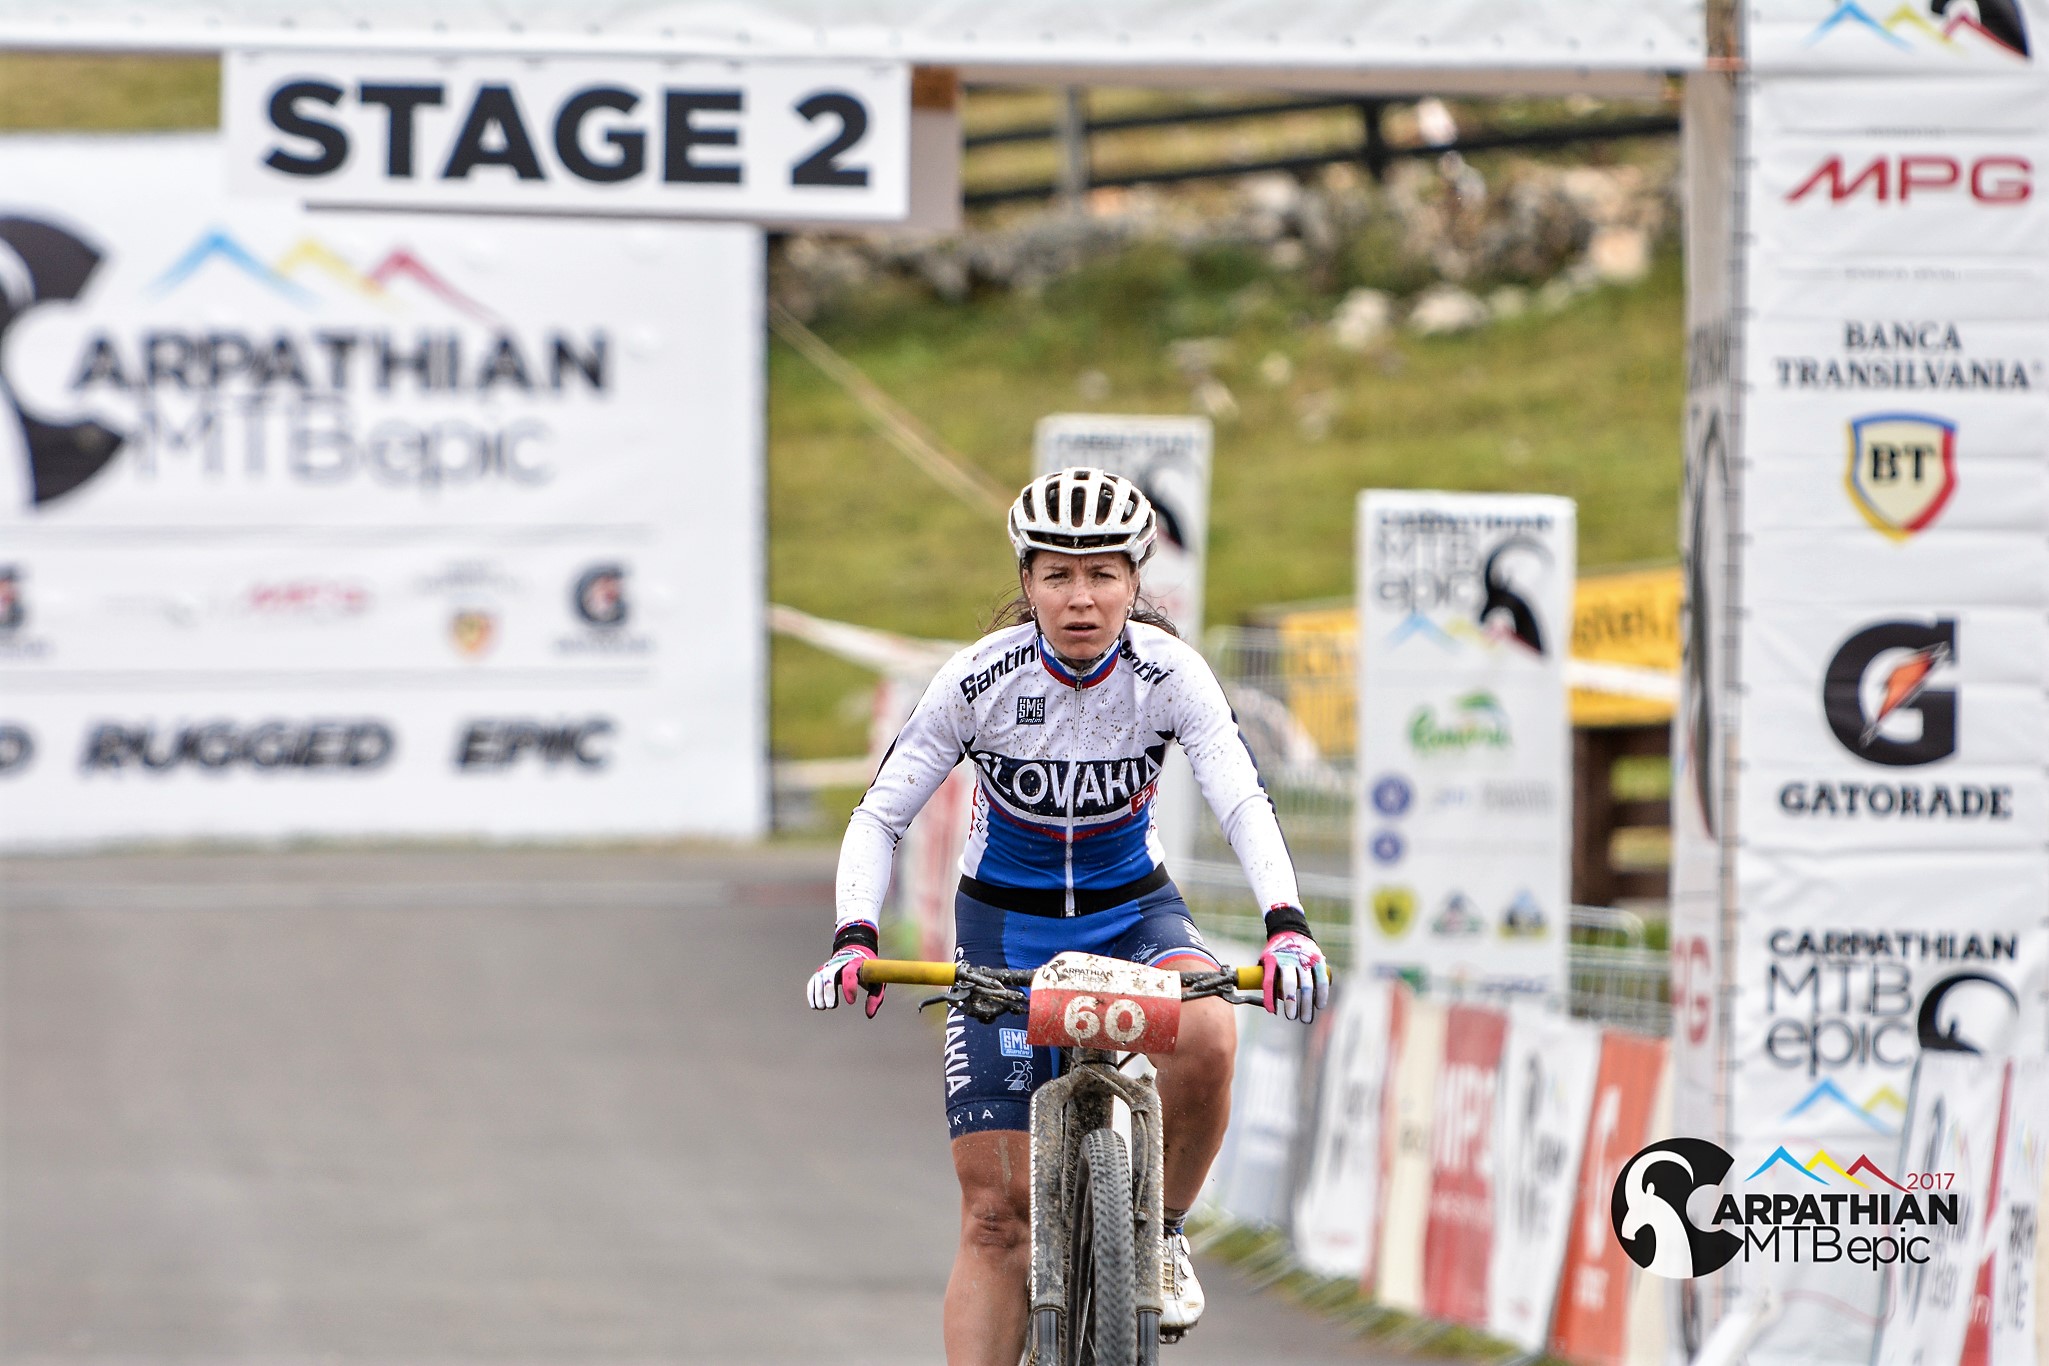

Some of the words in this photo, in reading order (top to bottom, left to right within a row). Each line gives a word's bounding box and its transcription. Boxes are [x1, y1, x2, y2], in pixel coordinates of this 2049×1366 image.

[263, 80, 744, 184] STAGE
[791, 91, 869, 186] 2
[1784, 153, 2034, 207] MPG
[1844, 321, 1963, 352] BANCA
[1870, 442, 1936, 484] BT
[959, 637, 1040, 705] Santini
[1823, 615, 1960, 768] G
[1778, 782, 2014, 819] GATORADE
[1768, 928, 2019, 960] CARPATHIAN
[1766, 961, 1914, 1017] MTB
[1064, 995, 1146, 1043] 60
[1765, 1018, 1914, 1078] epic
